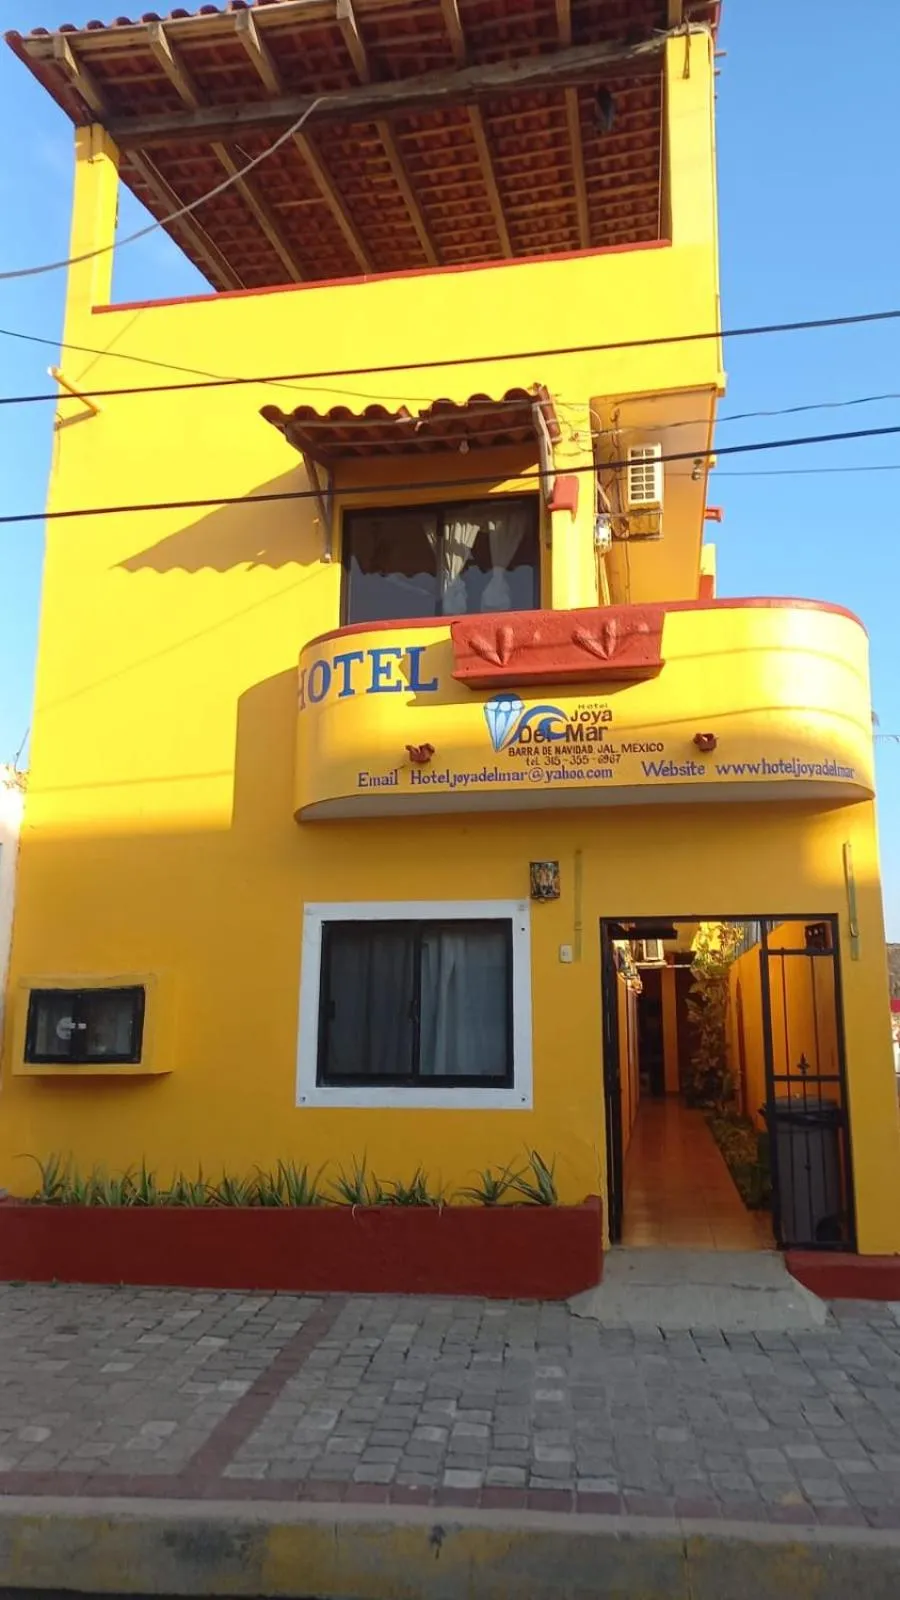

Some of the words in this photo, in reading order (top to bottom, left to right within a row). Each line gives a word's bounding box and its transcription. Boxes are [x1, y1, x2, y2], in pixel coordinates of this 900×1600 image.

[570, 709, 613, 724] Joya
[565, 724, 608, 742] Mar
[508, 745, 539, 757] BARRA
[542, 745, 552, 755] DE
[554, 744, 593, 755] NAVIDAD
[621, 742, 664, 753] MEXICO
[641, 760, 705, 777] Website
[358, 769, 398, 787] Email
